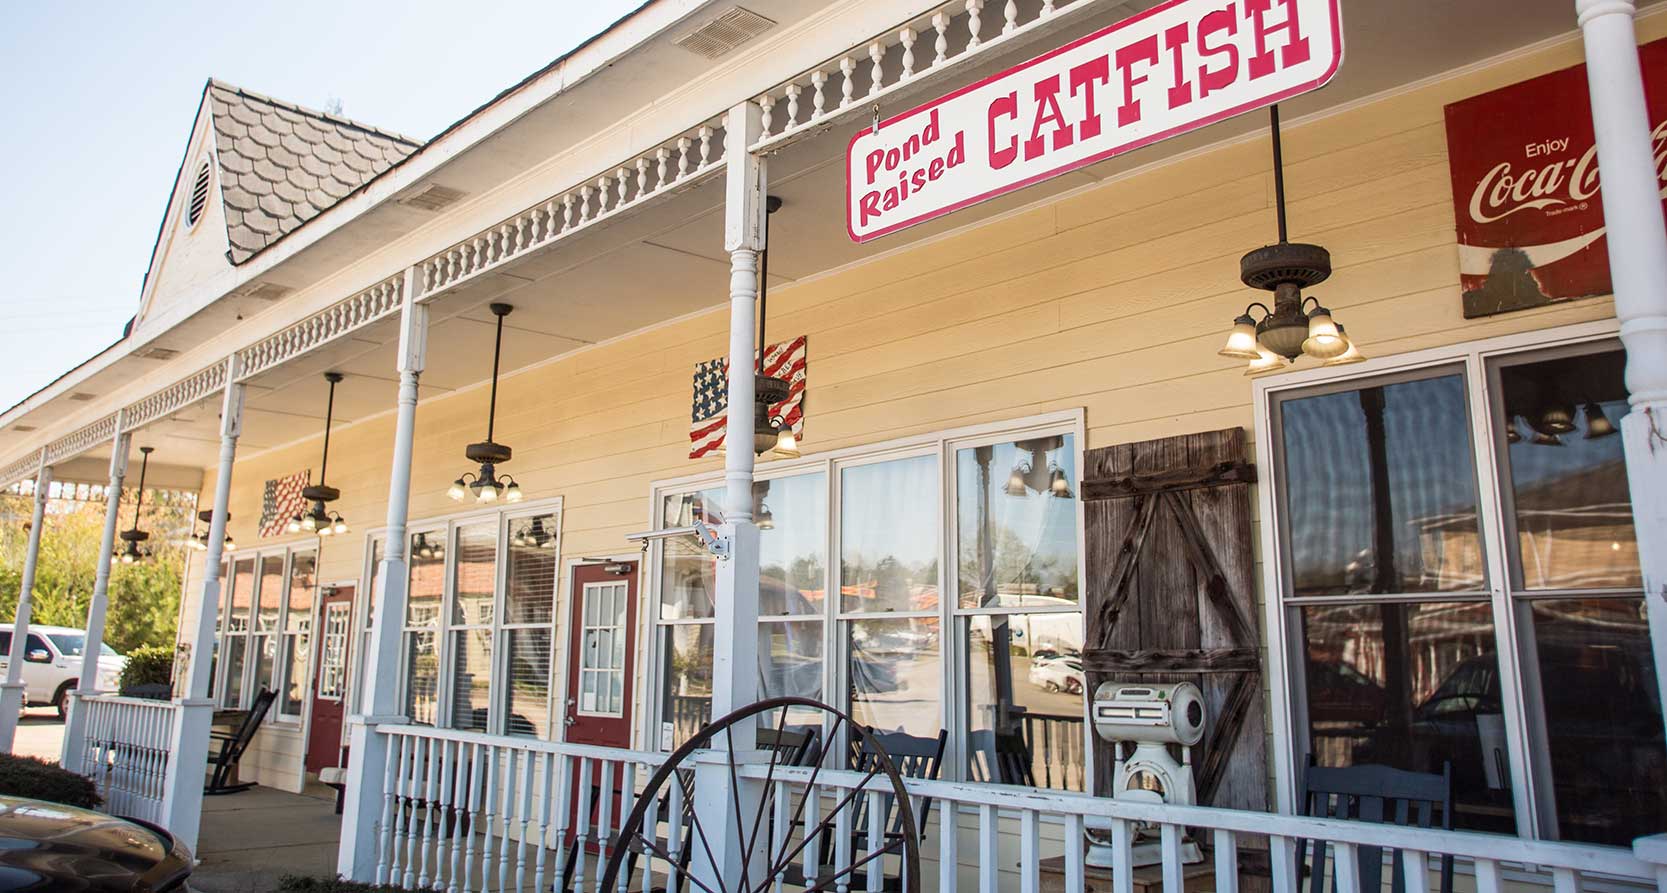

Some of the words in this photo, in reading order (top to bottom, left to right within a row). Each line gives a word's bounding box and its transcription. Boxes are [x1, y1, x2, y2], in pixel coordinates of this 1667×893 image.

[988, 0, 1310, 170] CATFISH
[859, 130, 965, 227] Raised
[866, 108, 940, 185] Pond
[1525, 137, 1569, 158] Enjoy
